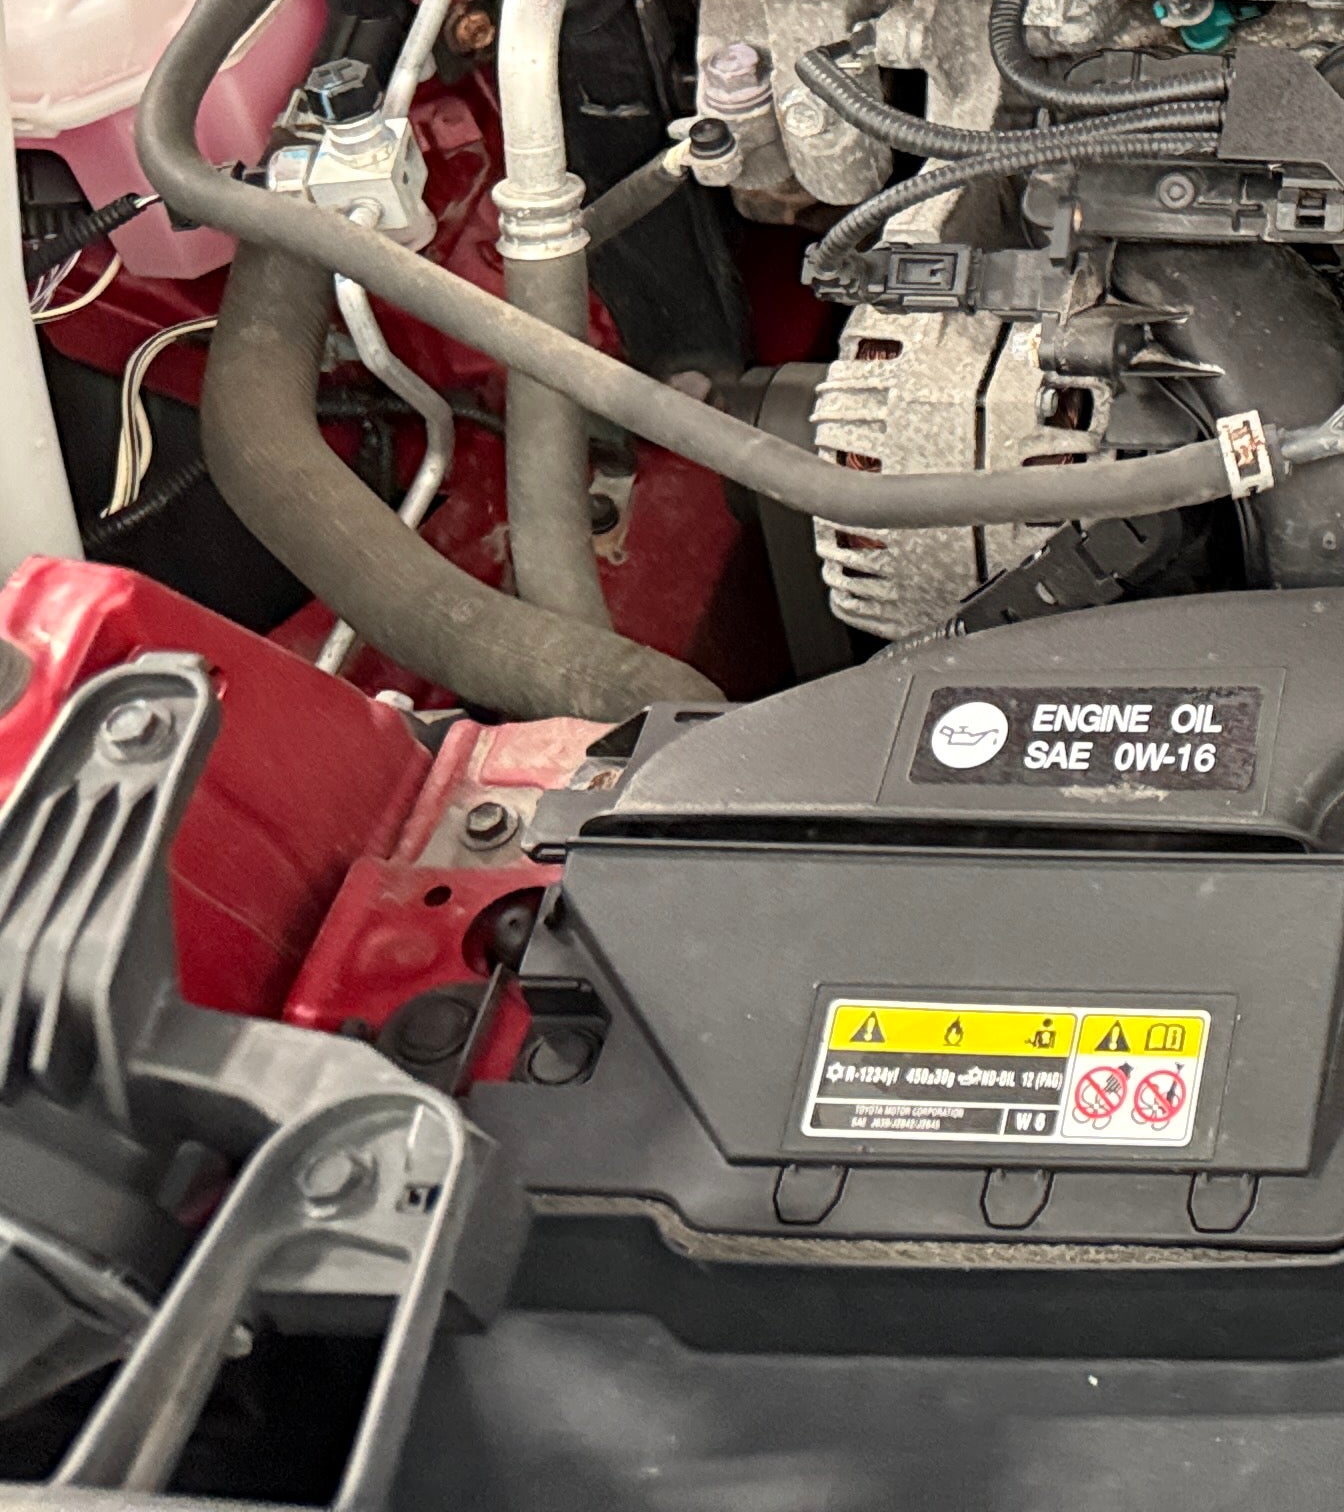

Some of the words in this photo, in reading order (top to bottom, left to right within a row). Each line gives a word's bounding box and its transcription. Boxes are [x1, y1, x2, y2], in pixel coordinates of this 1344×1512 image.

[1032, 704, 1152, 733] ENGINE
[1171, 704, 1222, 734] OIL
[1024, 740, 1093, 770] SAE
[1114, 742, 1216, 773] 0W-16
[845, 1065, 900, 1087] R-1234yf
[981, 1069, 1015, 1088] ND-OIL
[1022, 1071, 1034, 1088] 12
[855, 1104, 883, 1117] TOYOTA
[884, 1106, 911, 1118] MOTOR
[912, 1107, 964, 1120] CORPORATION
[1017, 1111, 1032, 1131] W
